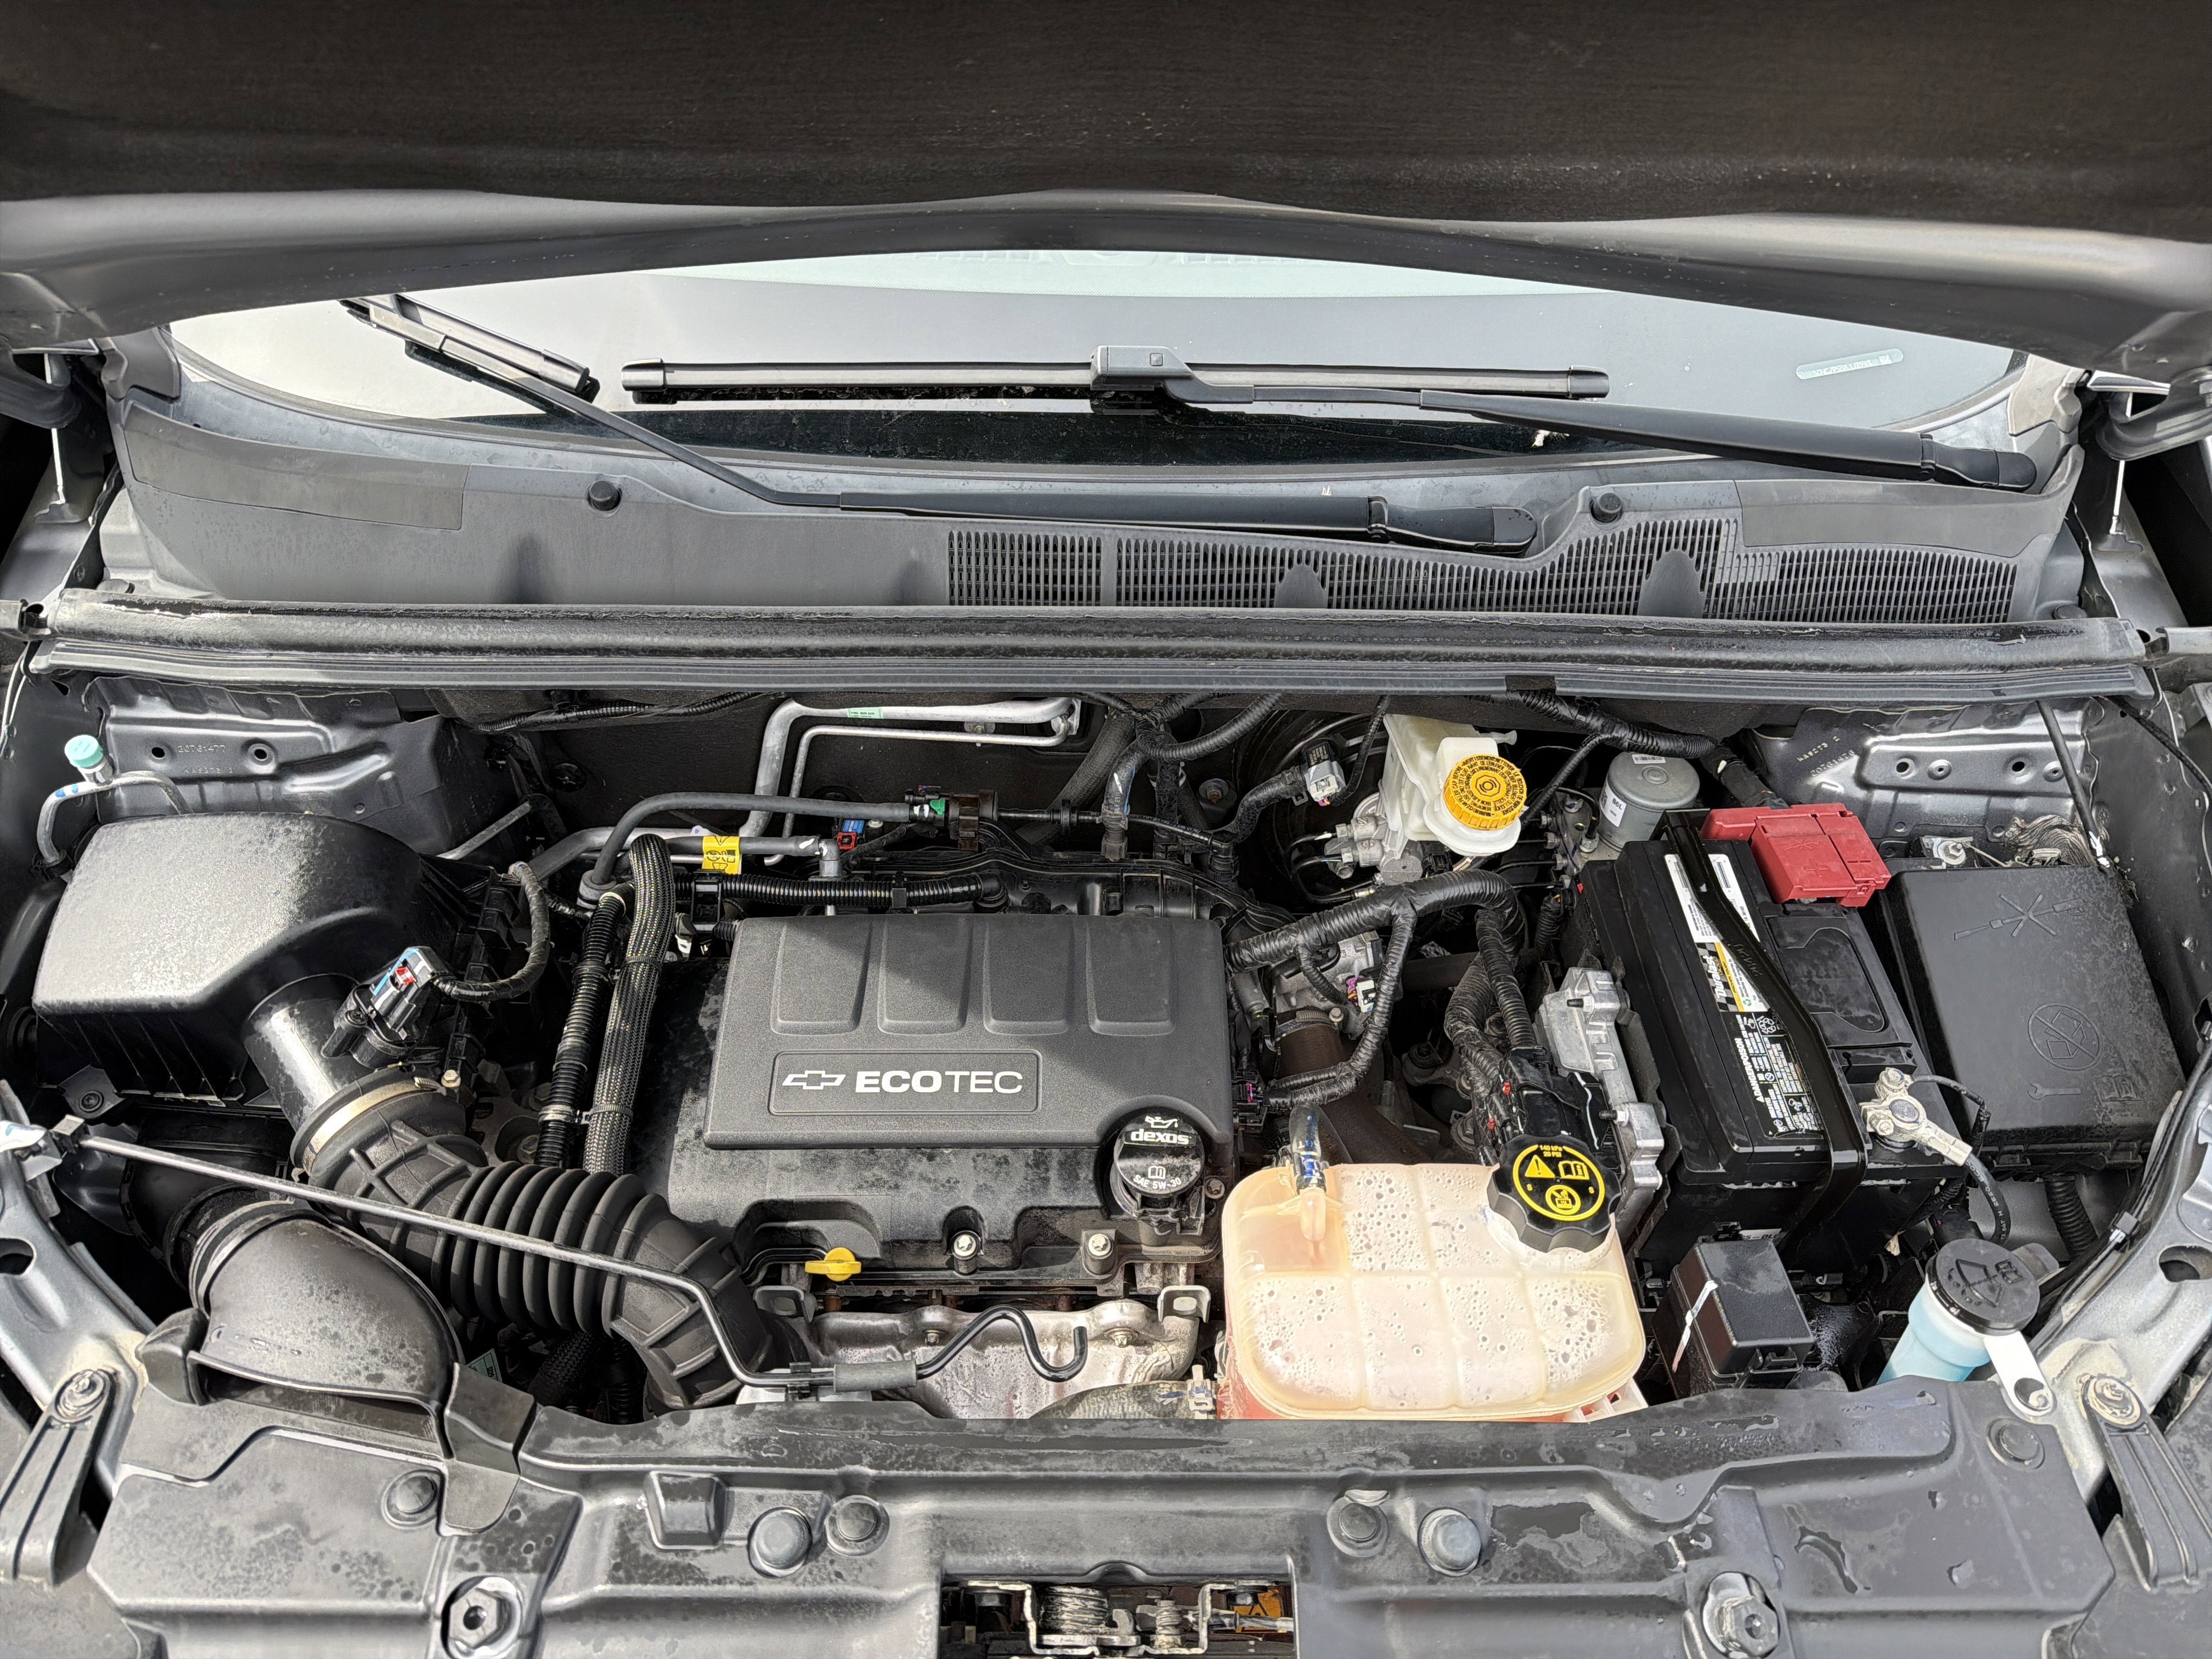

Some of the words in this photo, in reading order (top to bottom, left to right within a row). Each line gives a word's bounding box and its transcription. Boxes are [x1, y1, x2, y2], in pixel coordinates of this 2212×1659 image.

[1612, 798, 1623, 810] B6L
[1702, 956, 1728, 999] Duralast
[1735, 1039, 1762, 1096] DANGER/POISON
[855, 1070, 1023, 1094] ECOTEC
[1131, 1128, 1189, 1145] dexos
[1133, 1174, 1150, 1188] SAE
[1152, 1177, 1182, 1189] 5W-30
